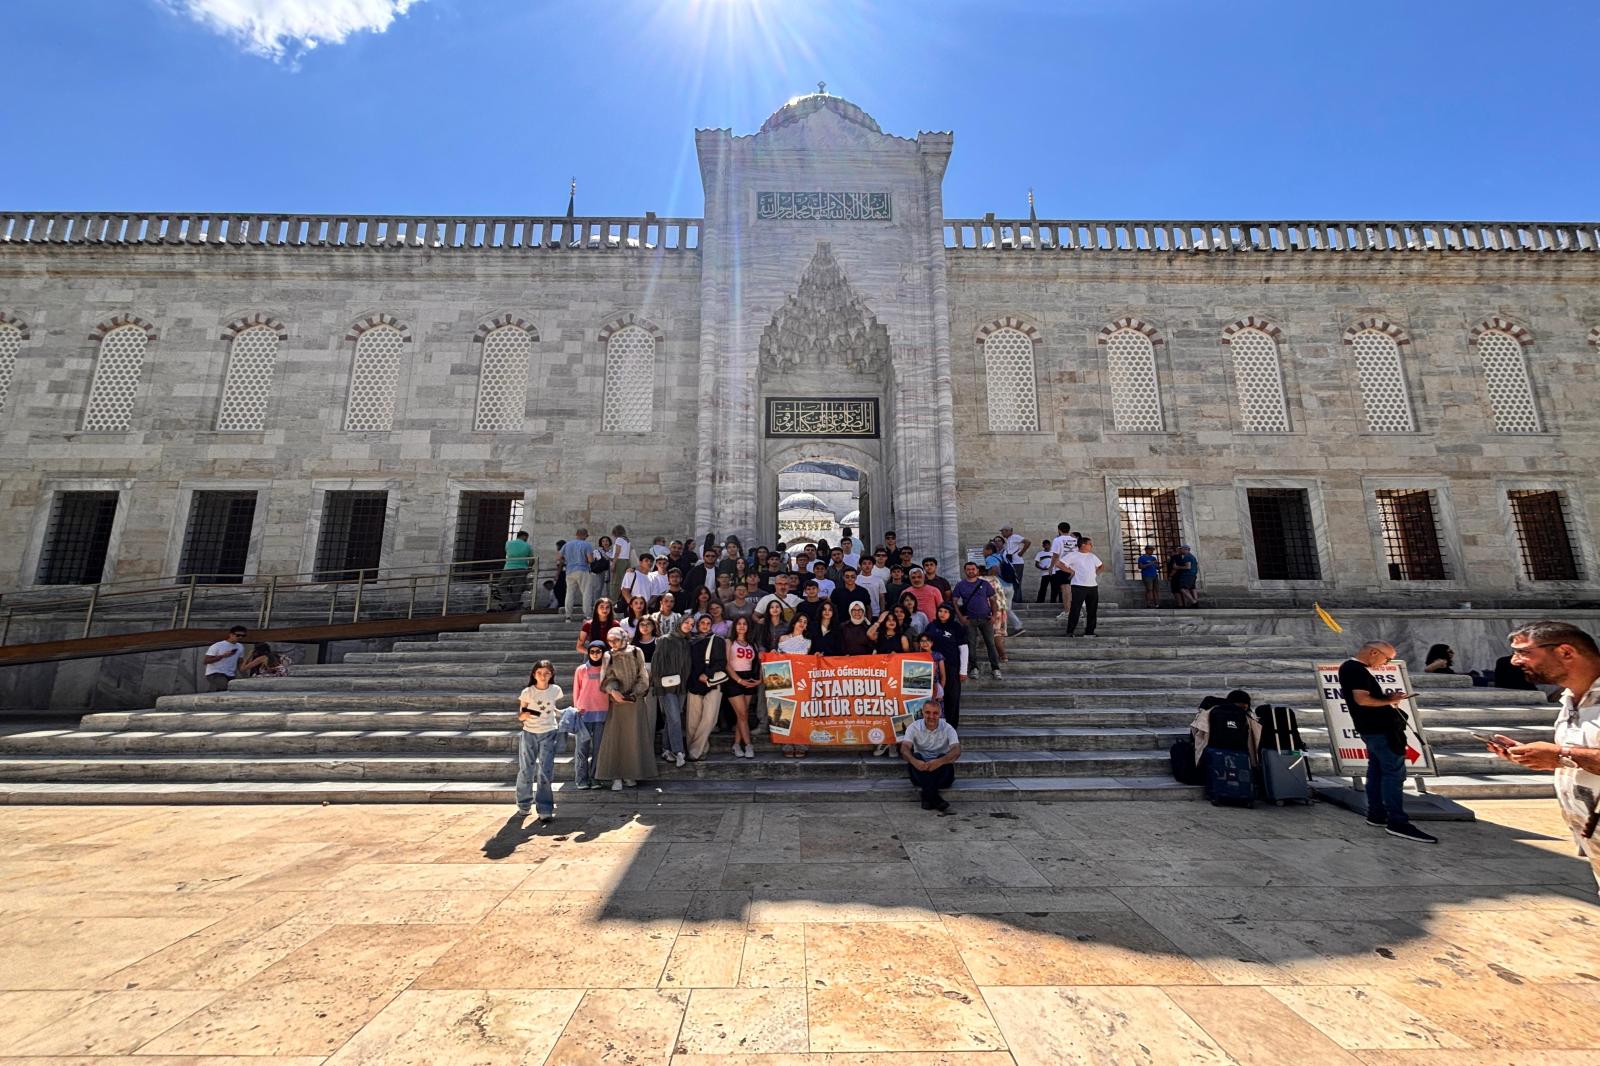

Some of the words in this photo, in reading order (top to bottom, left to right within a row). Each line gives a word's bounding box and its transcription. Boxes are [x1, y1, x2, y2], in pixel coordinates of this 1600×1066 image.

[736, 647, 753, 660] 98
[837, 665, 887, 678] ÖĞRENCİLERİ
[811, 678, 885, 698] İSTANBUL
[800, 696, 850, 717] KÜLTÜR
[853, 696, 899, 716] GEZİSİ
